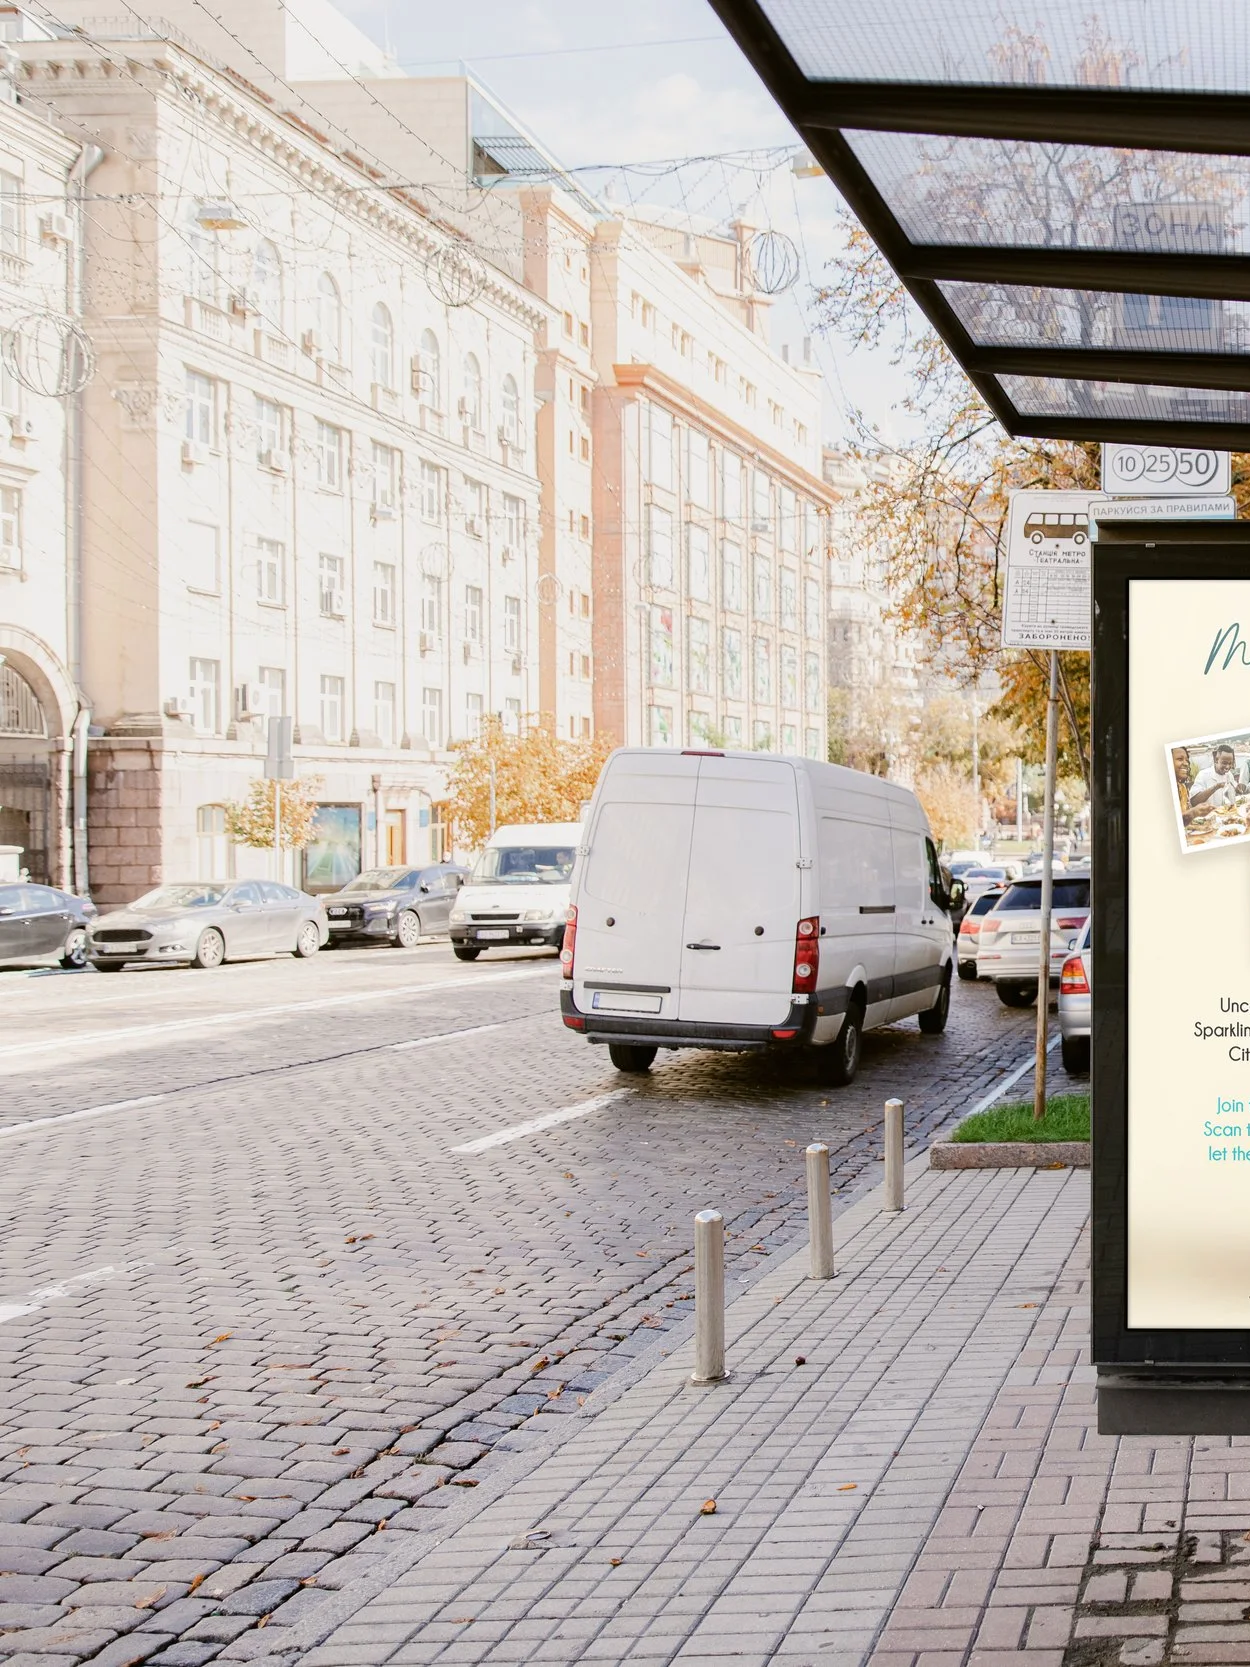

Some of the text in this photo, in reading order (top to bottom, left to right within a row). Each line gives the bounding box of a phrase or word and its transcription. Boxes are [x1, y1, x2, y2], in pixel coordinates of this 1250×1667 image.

[1121, 210, 1216, 236] ЗОНА
[1118, 452, 1210, 475] 10 25 50
[1093, 503, 1230, 516] ПАРКУЙСЯ ЗА ПРАВИЛАМИ
[1216, 1097, 1244, 1115] Join
[1203, 1121, 1242, 1137] Scan
[1208, 1146, 1228, 1162] let
